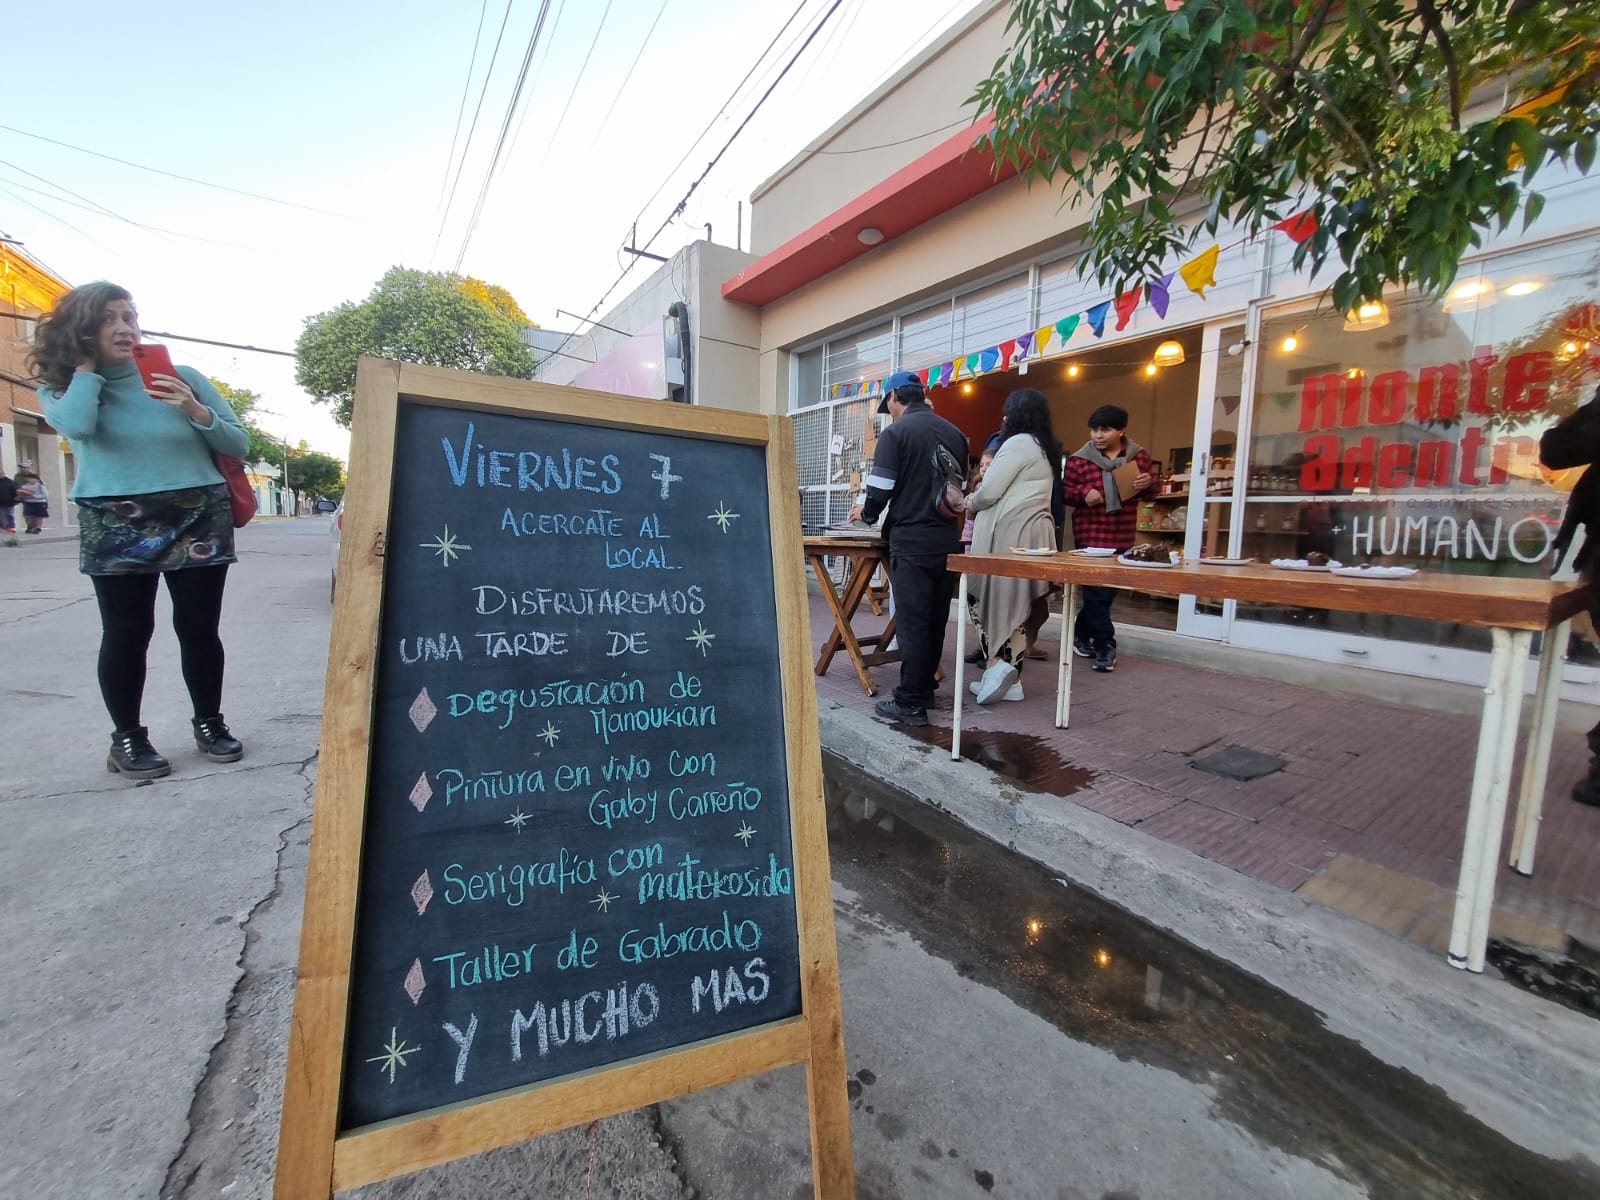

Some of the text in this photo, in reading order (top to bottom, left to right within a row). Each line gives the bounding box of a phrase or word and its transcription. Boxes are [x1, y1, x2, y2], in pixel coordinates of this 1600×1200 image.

[1298, 345, 1554, 433] monte
[650, 452, 683, 500] 7
[1300, 426, 1540, 492] adentr
[501, 507, 671, 538] ACERCATE AL
[1352, 515, 1550, 563] HUMANO
[400, 630, 650, 664] UNA TARDE DE
[446, 671, 701, 729] Degustación de
[436, 768, 545, 806] Pintura
[554, 764, 591, 792] en
[602, 754, 651, 782] vivo
[588, 781, 762, 829] Gaby Carreño
[443, 842, 663, 907] Serigrafía con
[432, 943, 537, 989] Taller
[556, 928, 599, 970] de
[442, 957, 770, 1085] Y MUCHO MAS
